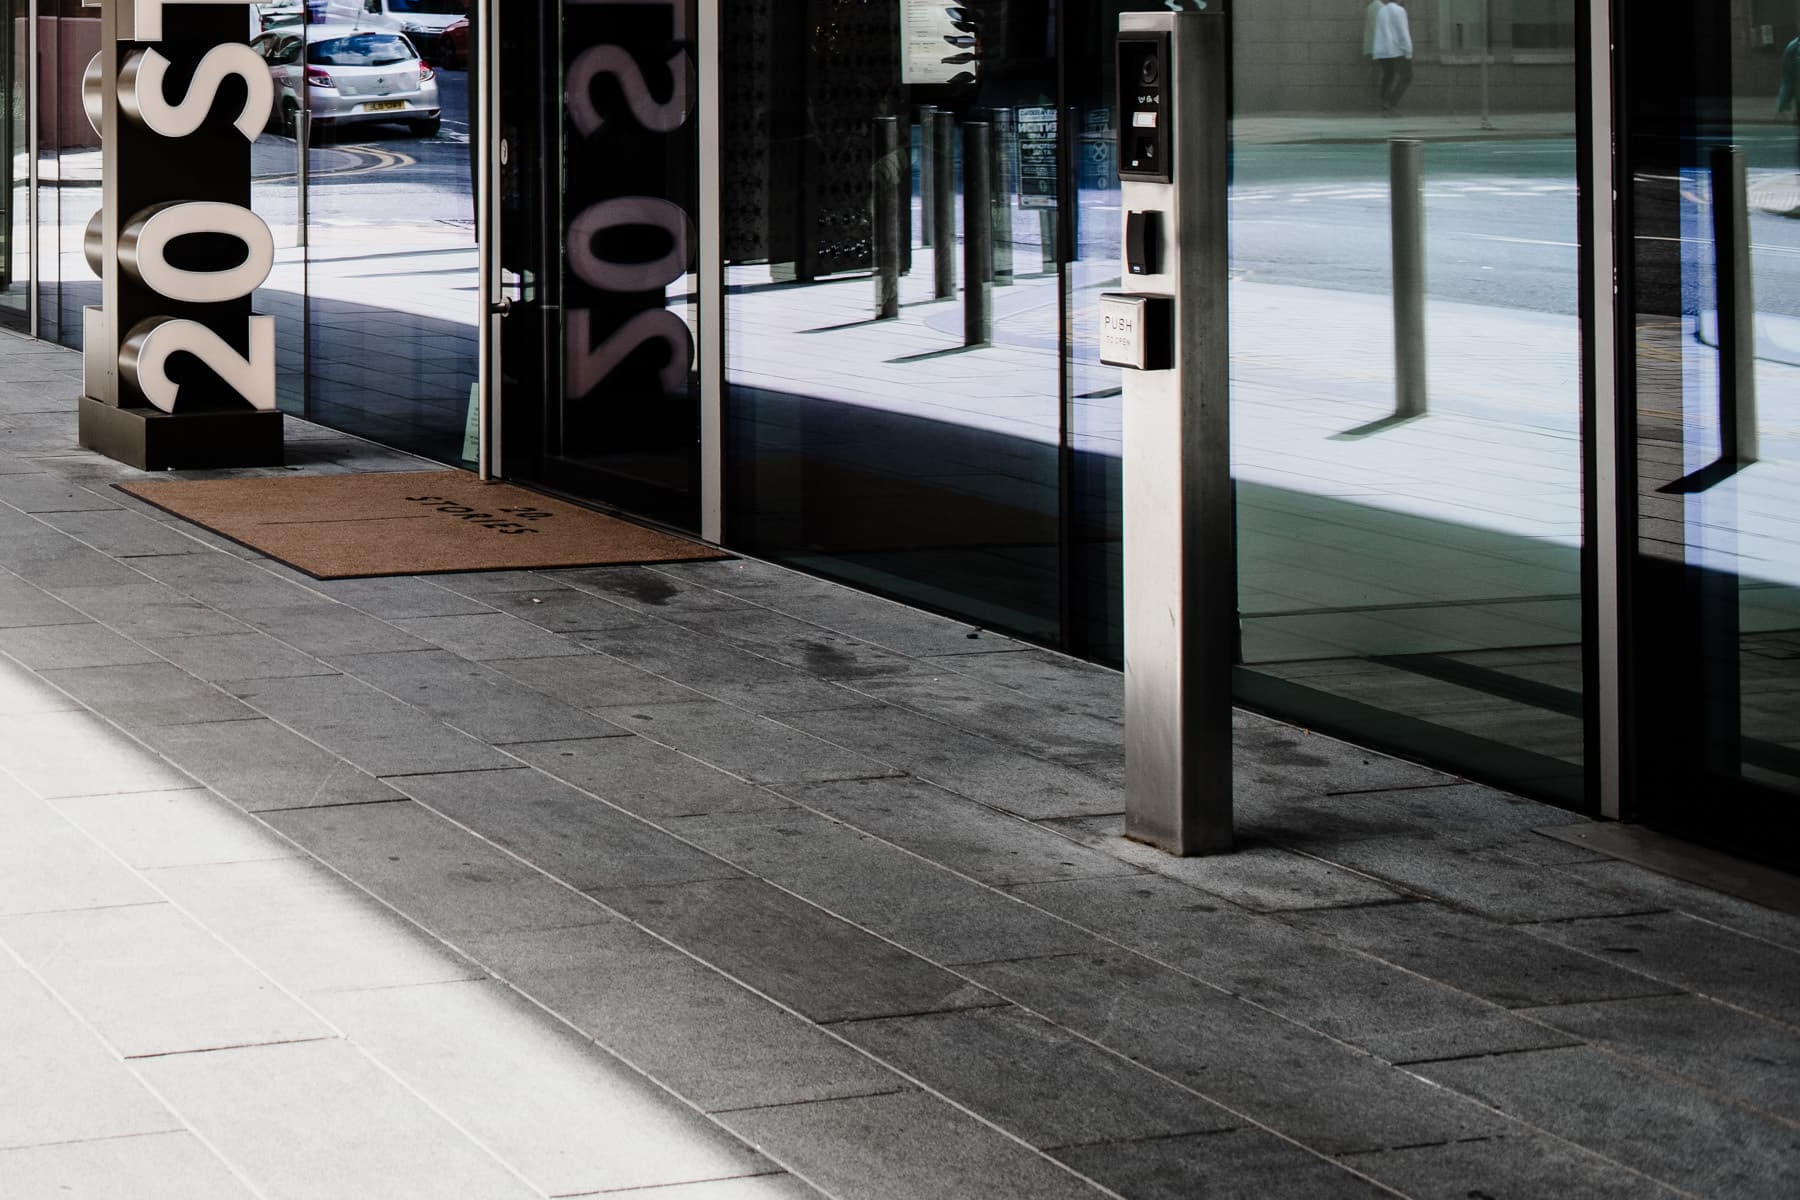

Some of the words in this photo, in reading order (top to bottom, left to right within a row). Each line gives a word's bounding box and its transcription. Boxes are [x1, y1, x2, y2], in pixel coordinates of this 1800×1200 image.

[132, 201, 276, 414] 20
[1104, 315, 1133, 333] PUSH
[405, 496, 539, 535] STORIES
